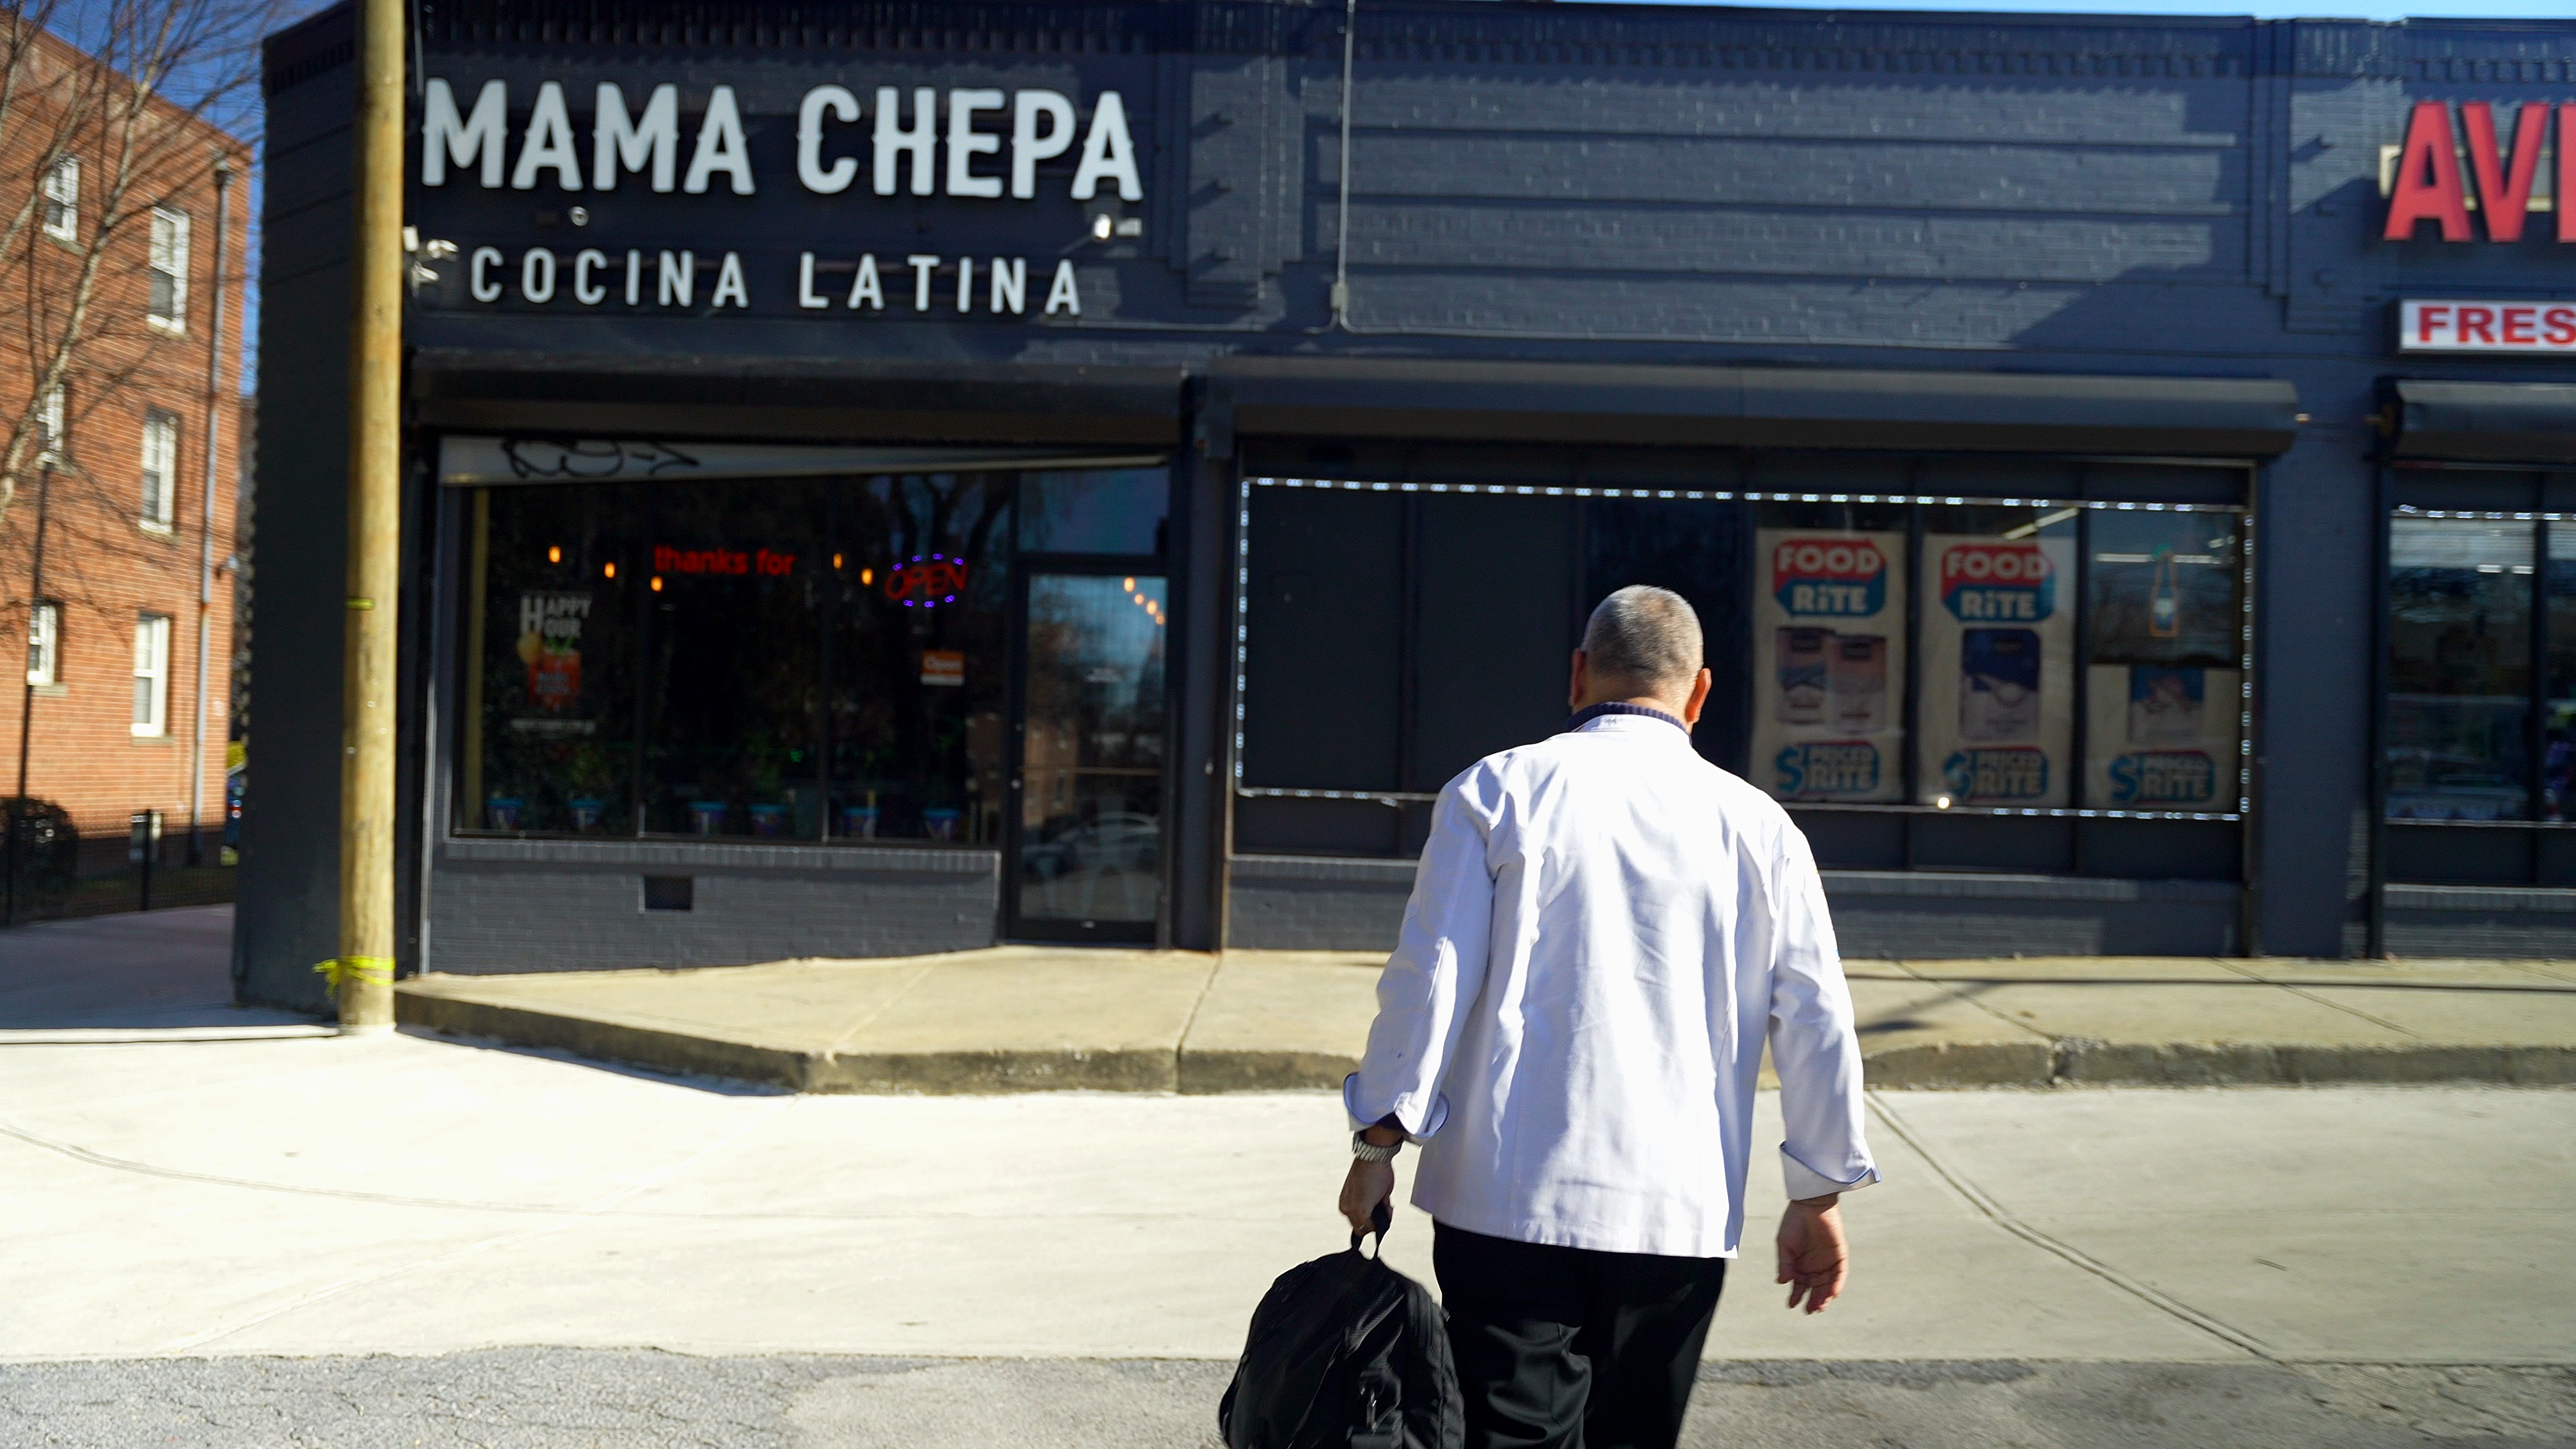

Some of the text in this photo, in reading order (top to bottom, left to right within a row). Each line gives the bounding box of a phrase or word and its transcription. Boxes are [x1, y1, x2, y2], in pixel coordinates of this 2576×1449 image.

[421, 77, 1143, 201] MAMA CHEPA
[2383, 100, 2576, 243] AV
[470, 246, 1081, 315] COCINA LATINA
[2418, 307, 2576, 345] FRES
[654, 545, 798, 576] thanks for
[1778, 545, 1880, 574] FOOD
[1947, 551, 2050, 580] FOOD
[885, 562, 968, 600] OPEN
